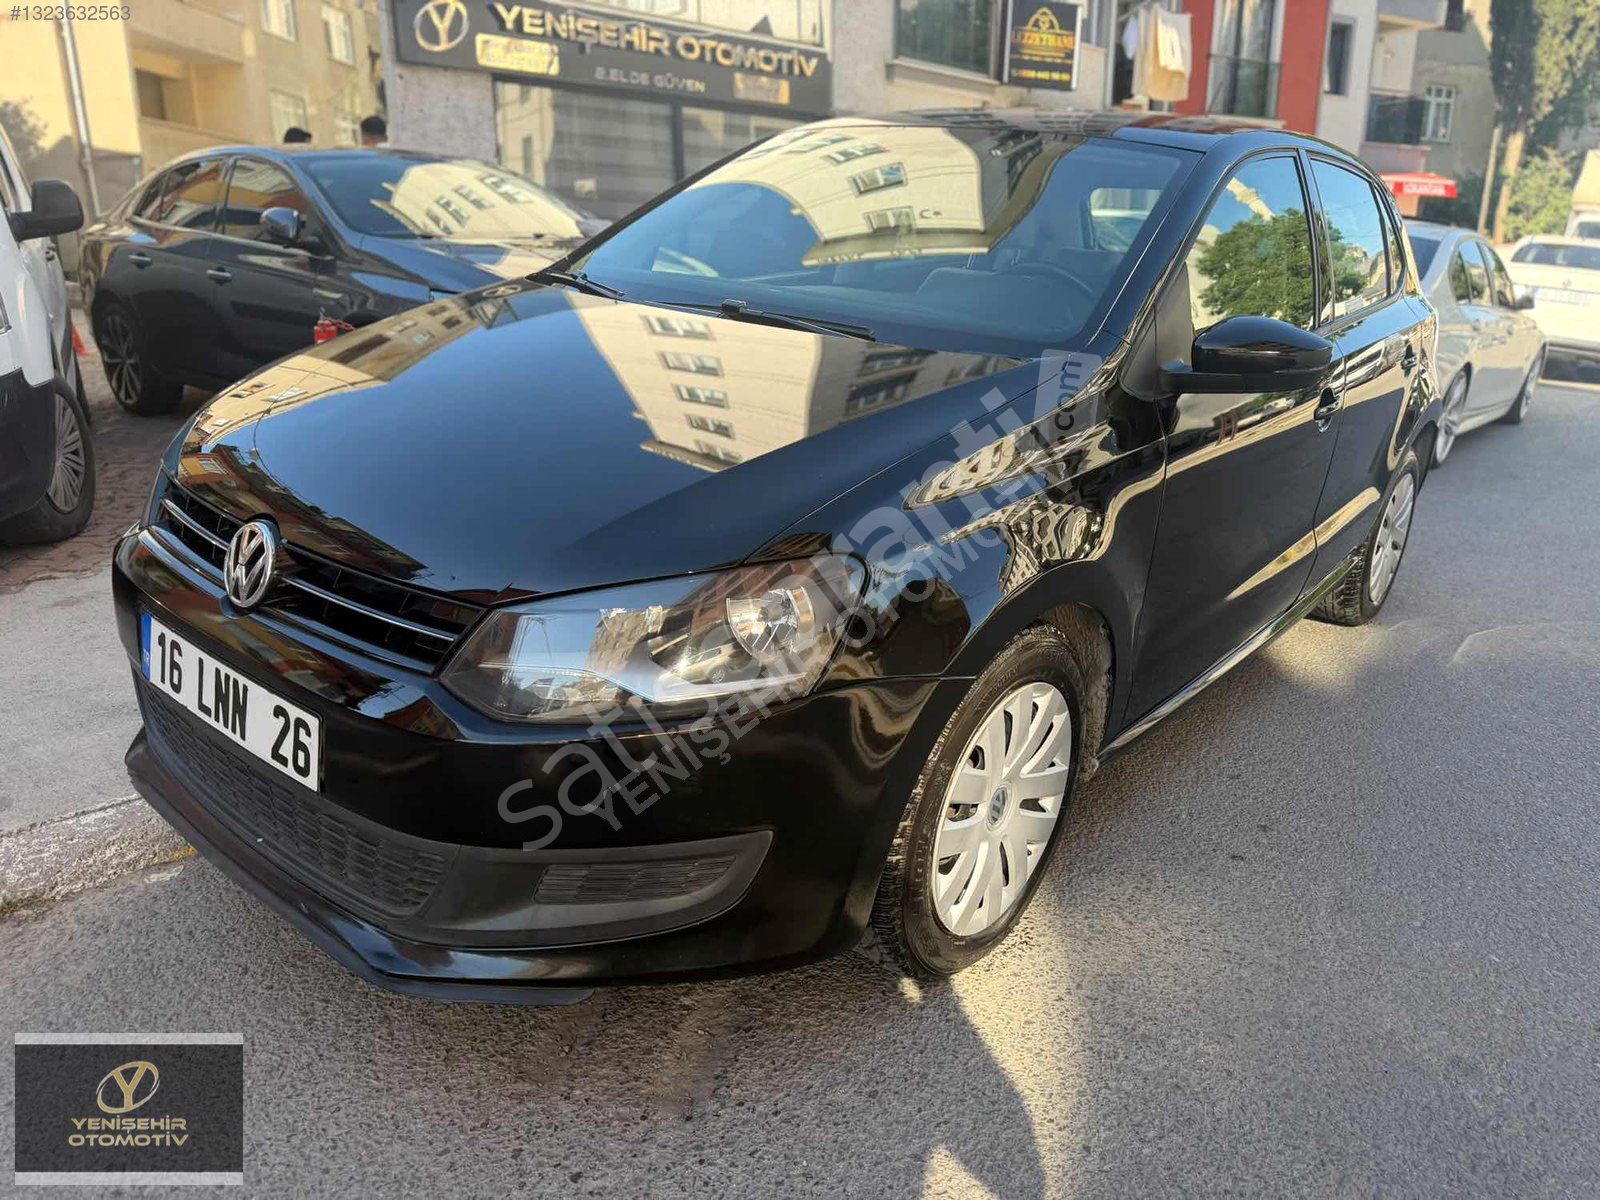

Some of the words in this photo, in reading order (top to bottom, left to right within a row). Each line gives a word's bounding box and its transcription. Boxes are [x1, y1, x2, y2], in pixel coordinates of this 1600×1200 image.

[675, 28, 819, 77] OTOMOTİV
[158, 632, 183, 694] 16
[198, 657, 248, 742] LNN
[271, 705, 311, 778] 26
